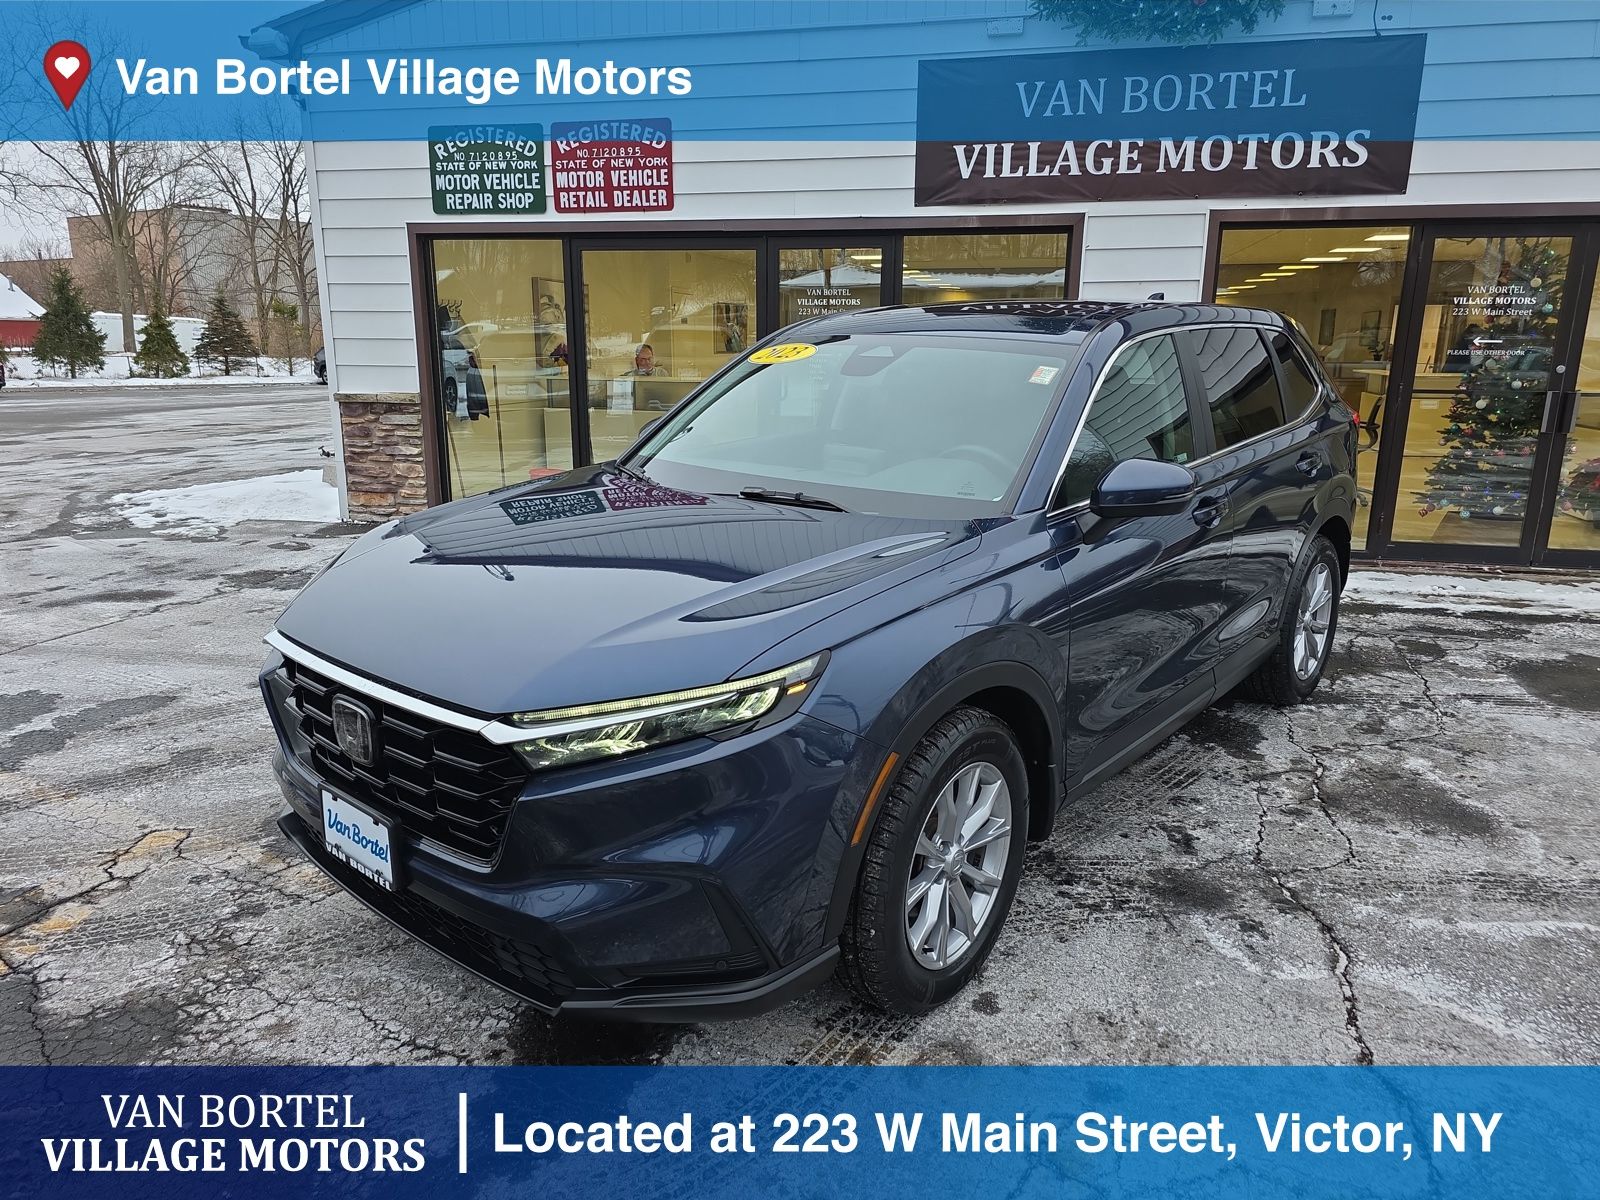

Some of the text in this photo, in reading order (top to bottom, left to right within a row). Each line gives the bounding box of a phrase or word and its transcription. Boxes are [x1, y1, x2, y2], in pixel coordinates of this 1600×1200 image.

[1015, 68, 1307, 118] VAN BORTEL
[434, 126, 537, 160] REGISTERED
[556, 122, 667, 154] REGISTERED
[577, 149, 590, 158] NO.
[952, 129, 1371, 180] VILLAGE MOTORS
[435, 160, 538, 171] STATE OF NEW YORK
[555, 157, 669, 169] STATE OF NEW YORK
[435, 172, 541, 191] MOTOR VEHICLE
[556, 168, 669, 189] MOTOR VEHICLE
[446, 192, 534, 210] REPAIR SHOP
[560, 189, 668, 209] RETAIL DEALER
[823, 288, 852, 296] BORTEL
[1468, 286, 1526, 294] VAN BORTEL
[797, 298, 861, 306] VILLAGE MOTORS
[1453, 297, 1537, 305] VILLAGE MOTORS
[1452, 307, 1533, 316] 223 W Main Street
[326, 842, 346, 862] VAN
